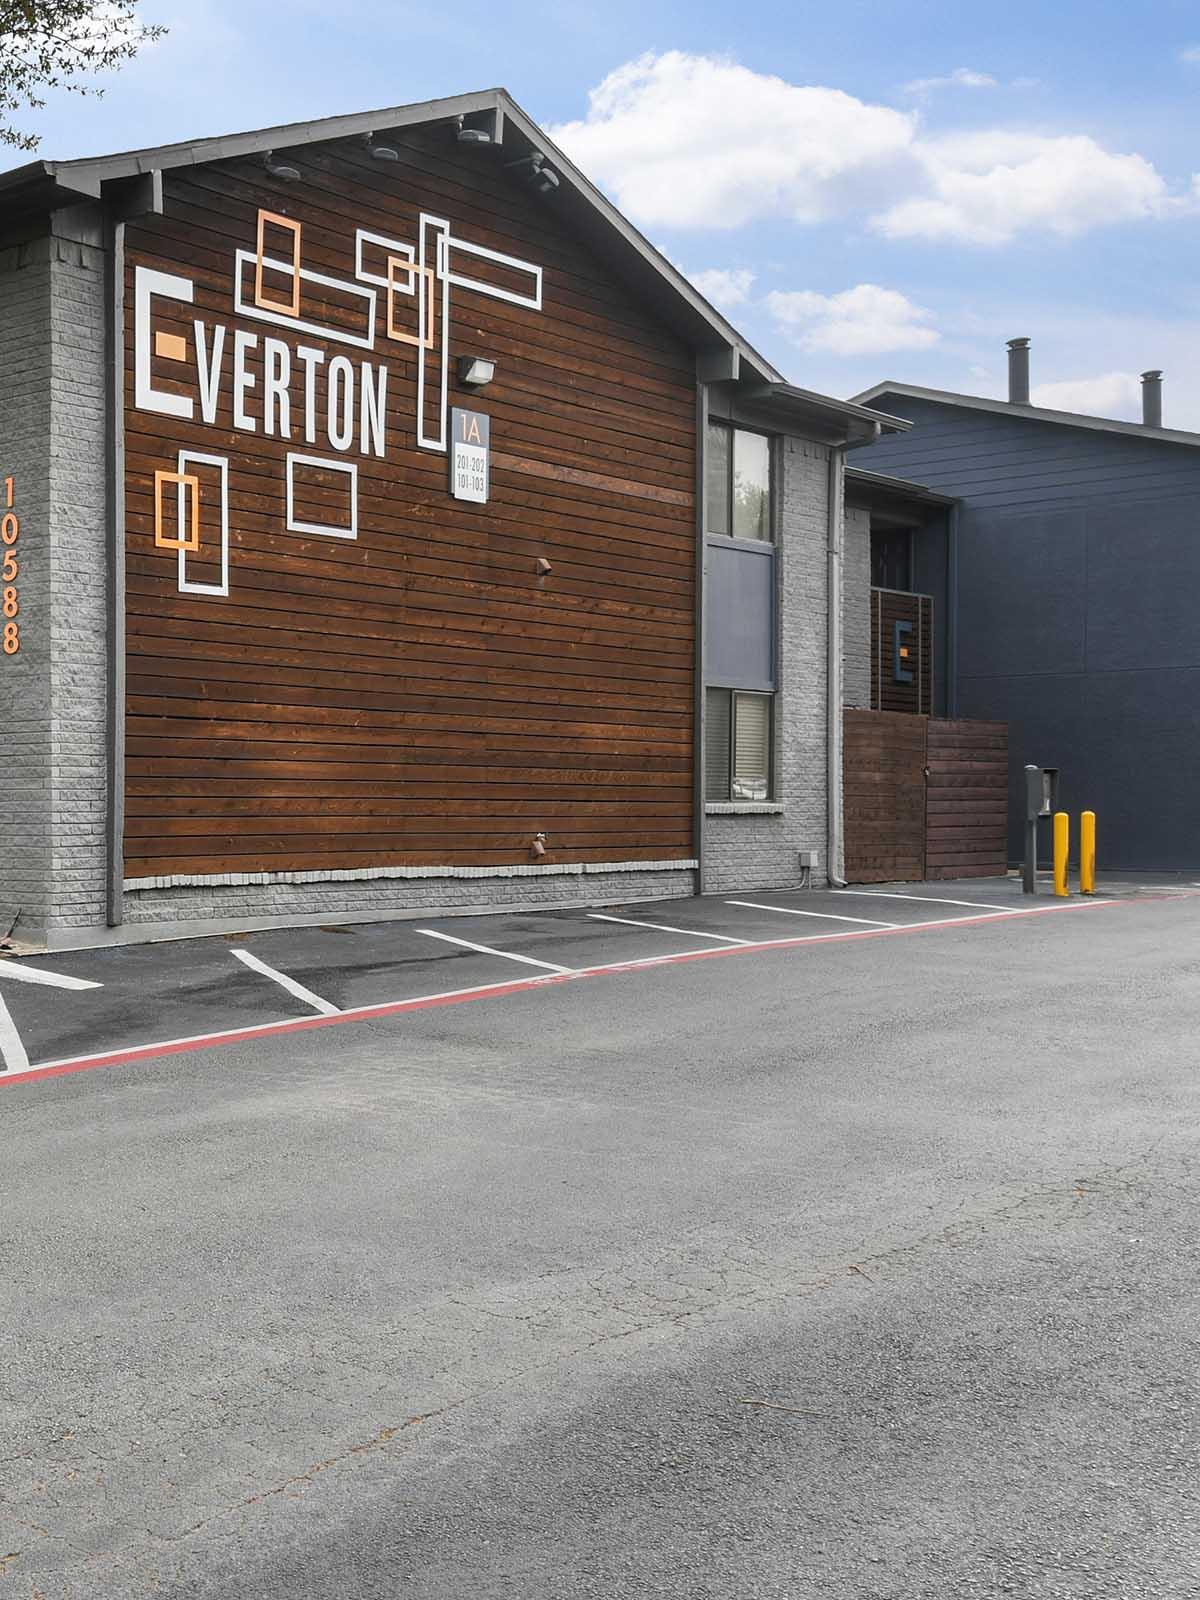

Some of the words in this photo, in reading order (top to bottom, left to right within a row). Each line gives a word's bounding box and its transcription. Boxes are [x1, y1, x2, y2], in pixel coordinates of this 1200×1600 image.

[135, 265, 388, 458] EVERTON
[461, 413, 481, 443] 1A
[457, 454, 485, 473] 201-202
[458, 473, 485, 492] 101-103
[1, 476, 20, 655] 10588
